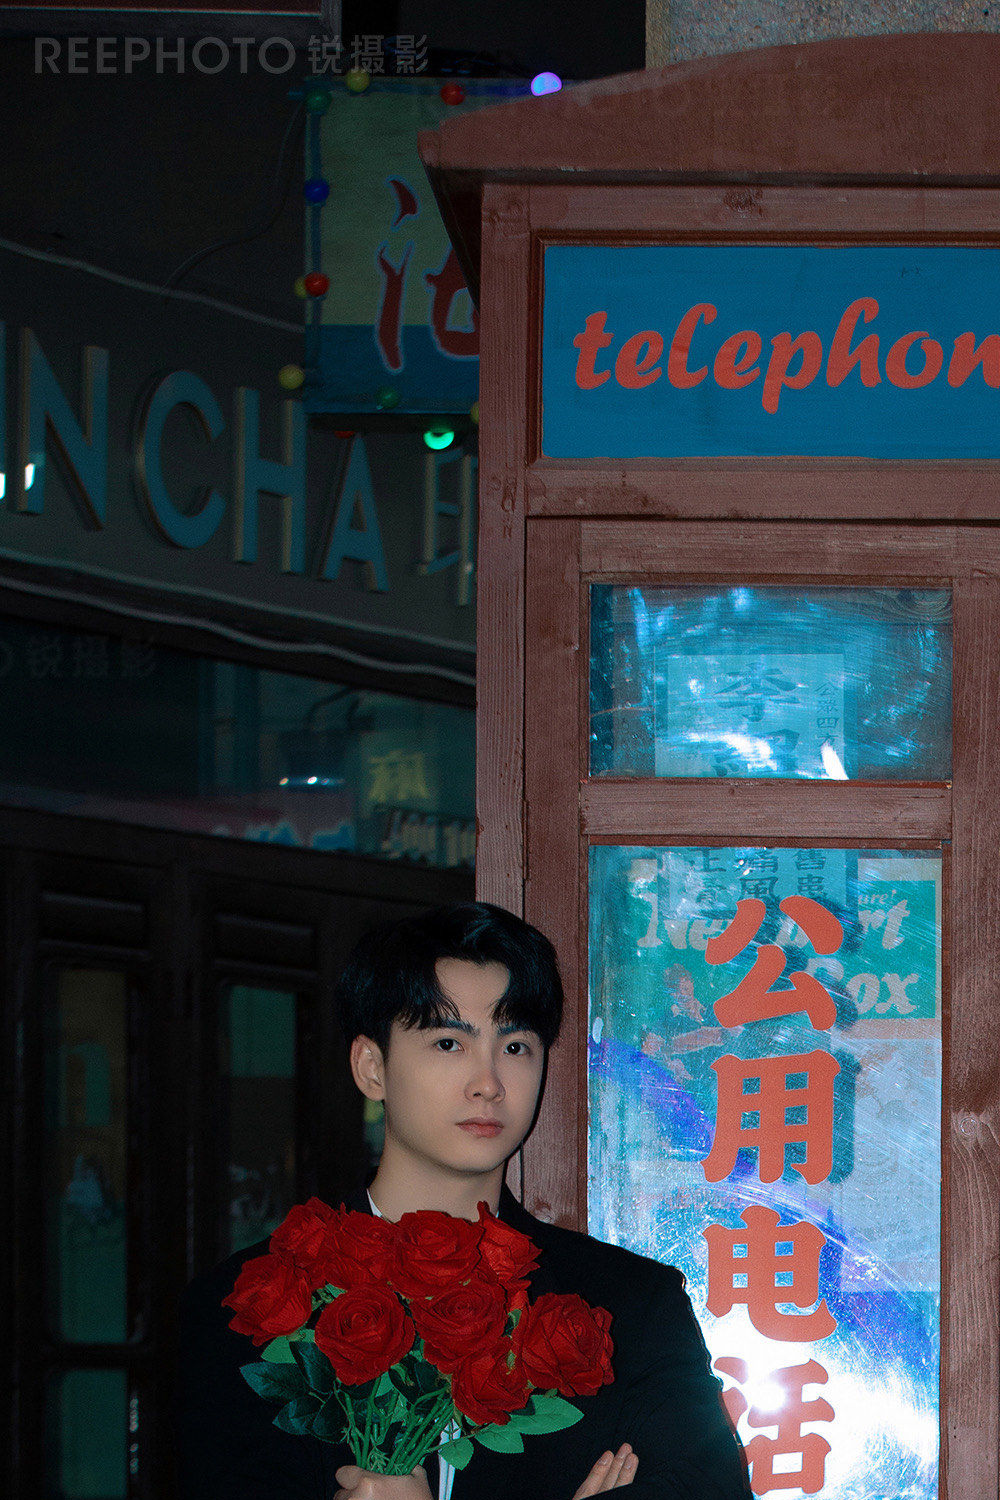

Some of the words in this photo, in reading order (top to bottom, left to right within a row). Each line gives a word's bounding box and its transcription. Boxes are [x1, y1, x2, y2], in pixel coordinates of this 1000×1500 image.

[0, 321, 391, 592] NCHA
[700, 895, 845, 1496] 公用电话
